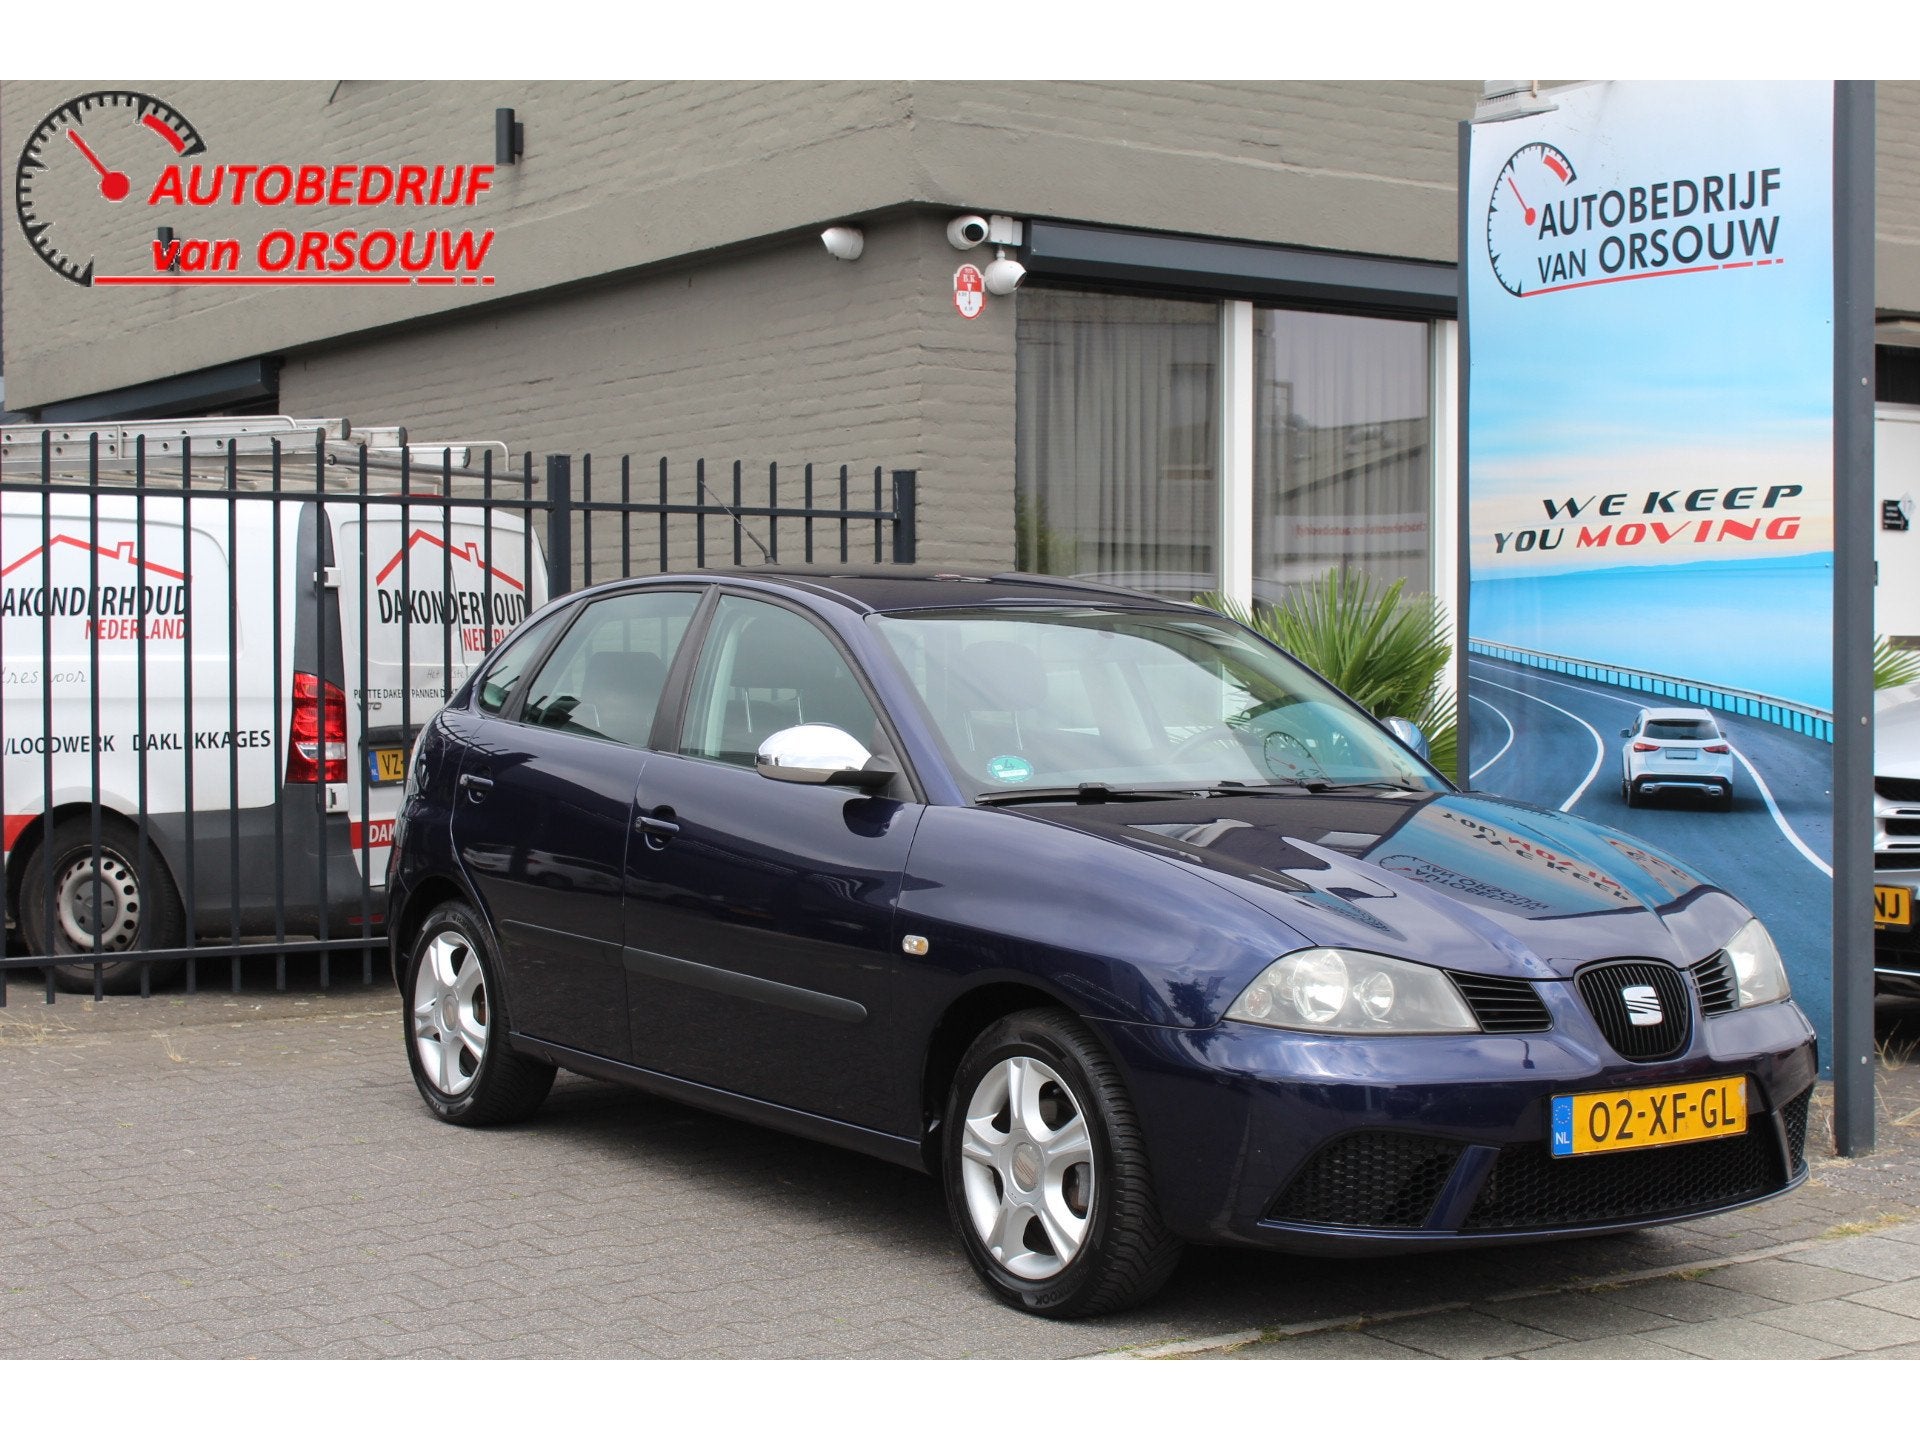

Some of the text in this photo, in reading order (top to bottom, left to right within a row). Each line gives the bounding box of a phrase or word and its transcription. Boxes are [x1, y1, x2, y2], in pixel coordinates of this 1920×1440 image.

[1538, 168, 1781, 241] AUTOBEDRIJF
[1537, 216, 1781, 284] VAN ORSOUW
[1542, 484, 1803, 520] WE KEEP
[1494, 516, 1802, 554] YOU MOVING
[1, 586, 187, 617] AKONDRHOUD
[378, 589, 527, 626] DAKONDEROUD
[383, 689, 404, 698] DAKE
[133, 730, 271, 751] DAKLKKAGES
[1589, 1087, 1736, 1143] 02-XF-GL
[1555, 1131, 1570, 1145] NL
